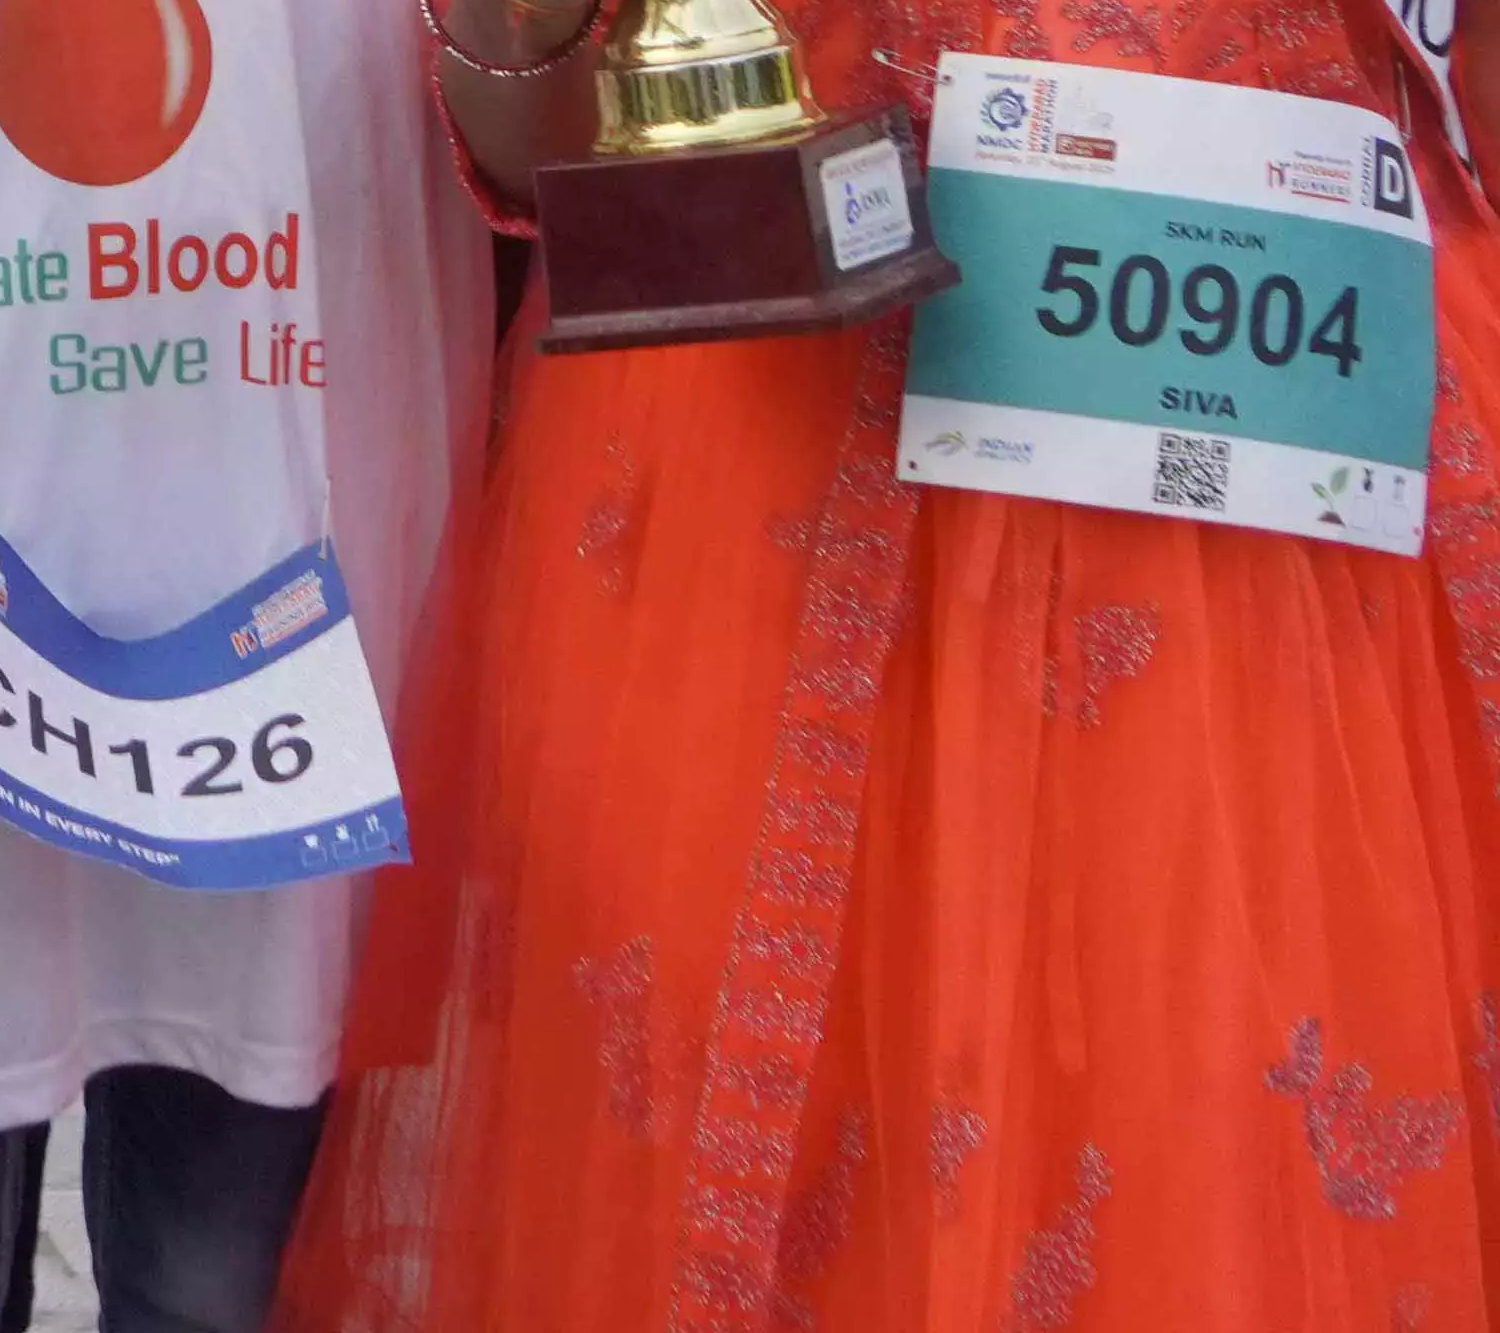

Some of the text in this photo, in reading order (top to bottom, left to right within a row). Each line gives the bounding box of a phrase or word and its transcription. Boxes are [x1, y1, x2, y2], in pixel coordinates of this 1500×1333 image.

[1380, 153, 1406, 203] D
[86, 212, 300, 303] Blood
[1165, 219, 1267, 253] 5KM RUN
[1035, 244, 1364, 379] 50904
[49, 319, 329, 397] Save Life
[1159, 385, 1239, 421] SIVA
[17, 796, 42, 823] IN
[43, 809, 115, 848] EVERY
